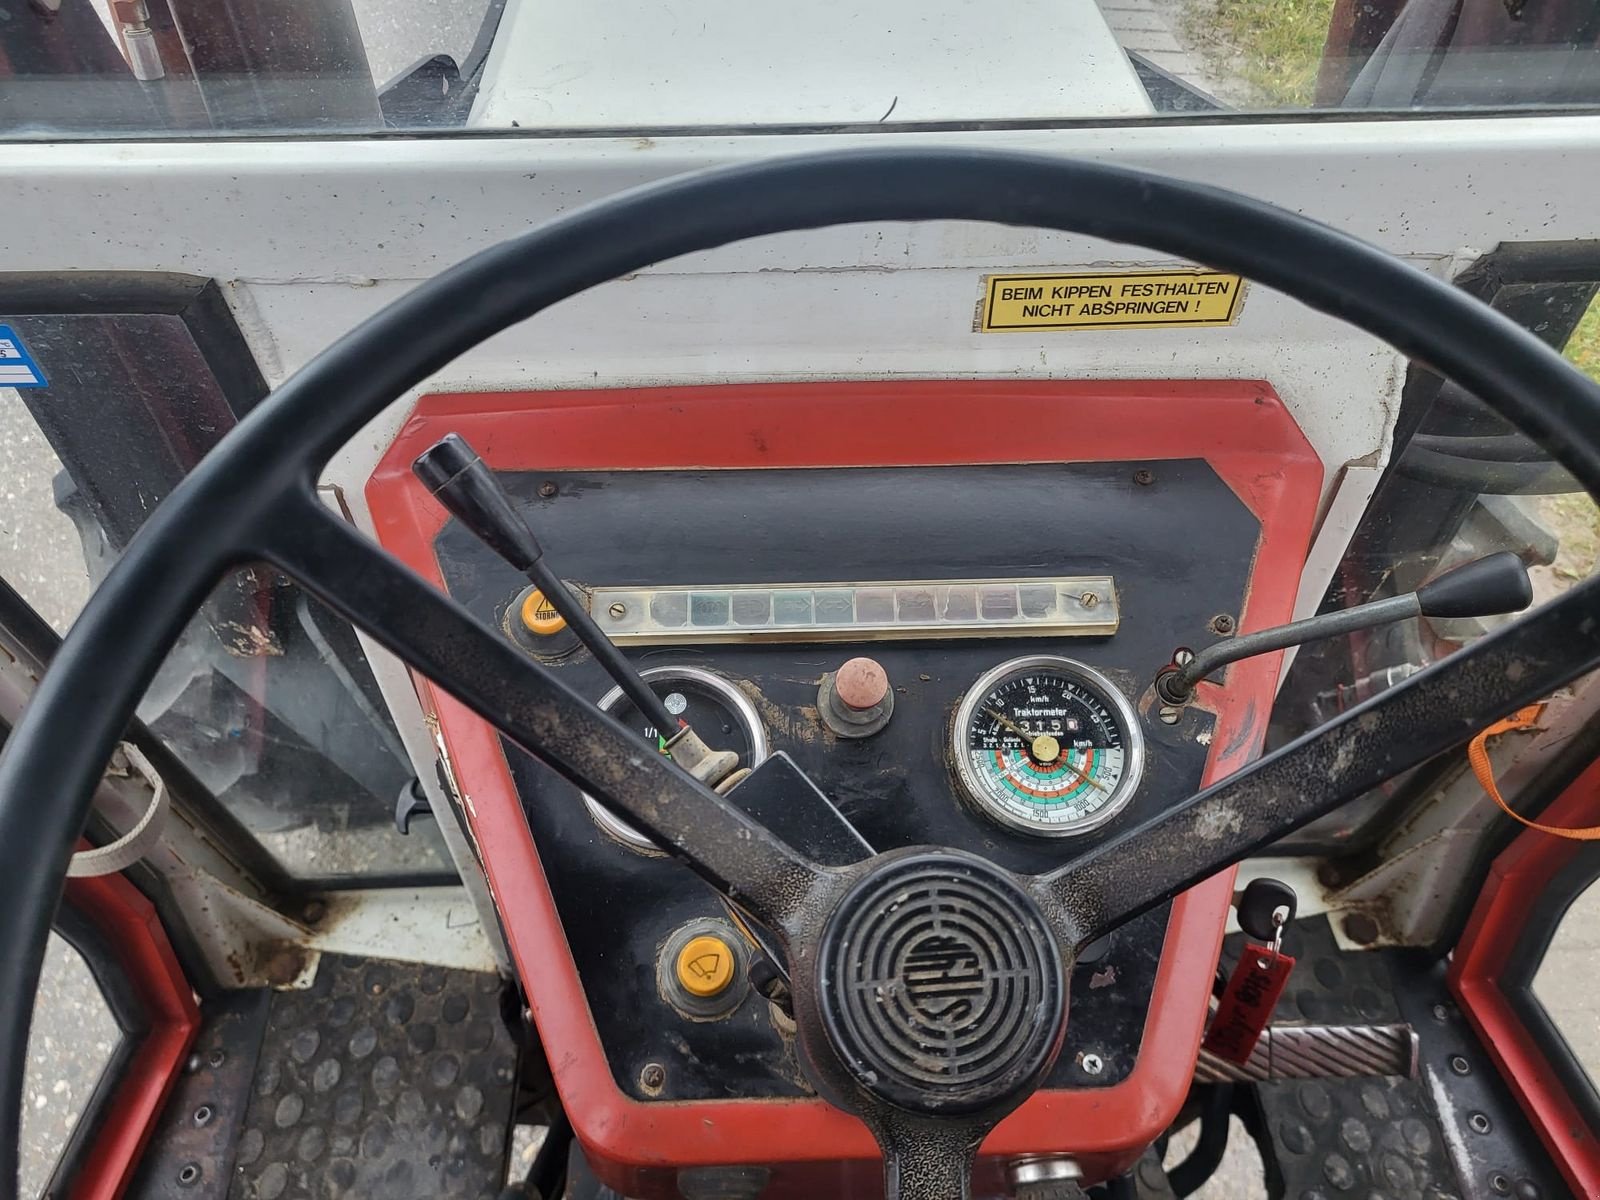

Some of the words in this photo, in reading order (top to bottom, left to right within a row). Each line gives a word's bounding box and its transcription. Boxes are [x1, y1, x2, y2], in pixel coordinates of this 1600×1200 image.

[1002, 287, 1043, 300] BEIM
[1051, 285, 1111, 299] KIPPEN
[1121, 282, 1229, 297] FESTHALTEN
[1022, 304, 1074, 317] NICHT
[1079, 301, 1189, 316] ABSPRINGEN
[1194, 300, 1200, 313] !
[1027, 686, 1036, 694] 15
[1062, 690, 1072, 700] 20
[995, 697, 1005, 708] 10
[1030, 695, 1049, 703] km/h
[1013, 708, 1068, 717] Traktormeter
[644, 727, 658, 738] 1/1
[977, 728, 987, 736] 5
[1103, 767, 1112, 781] 500
[1074, 799, 1090, 811] 1000
[1033, 809, 1049, 819] 1500
[903, 936, 983, 1022] STEYR
